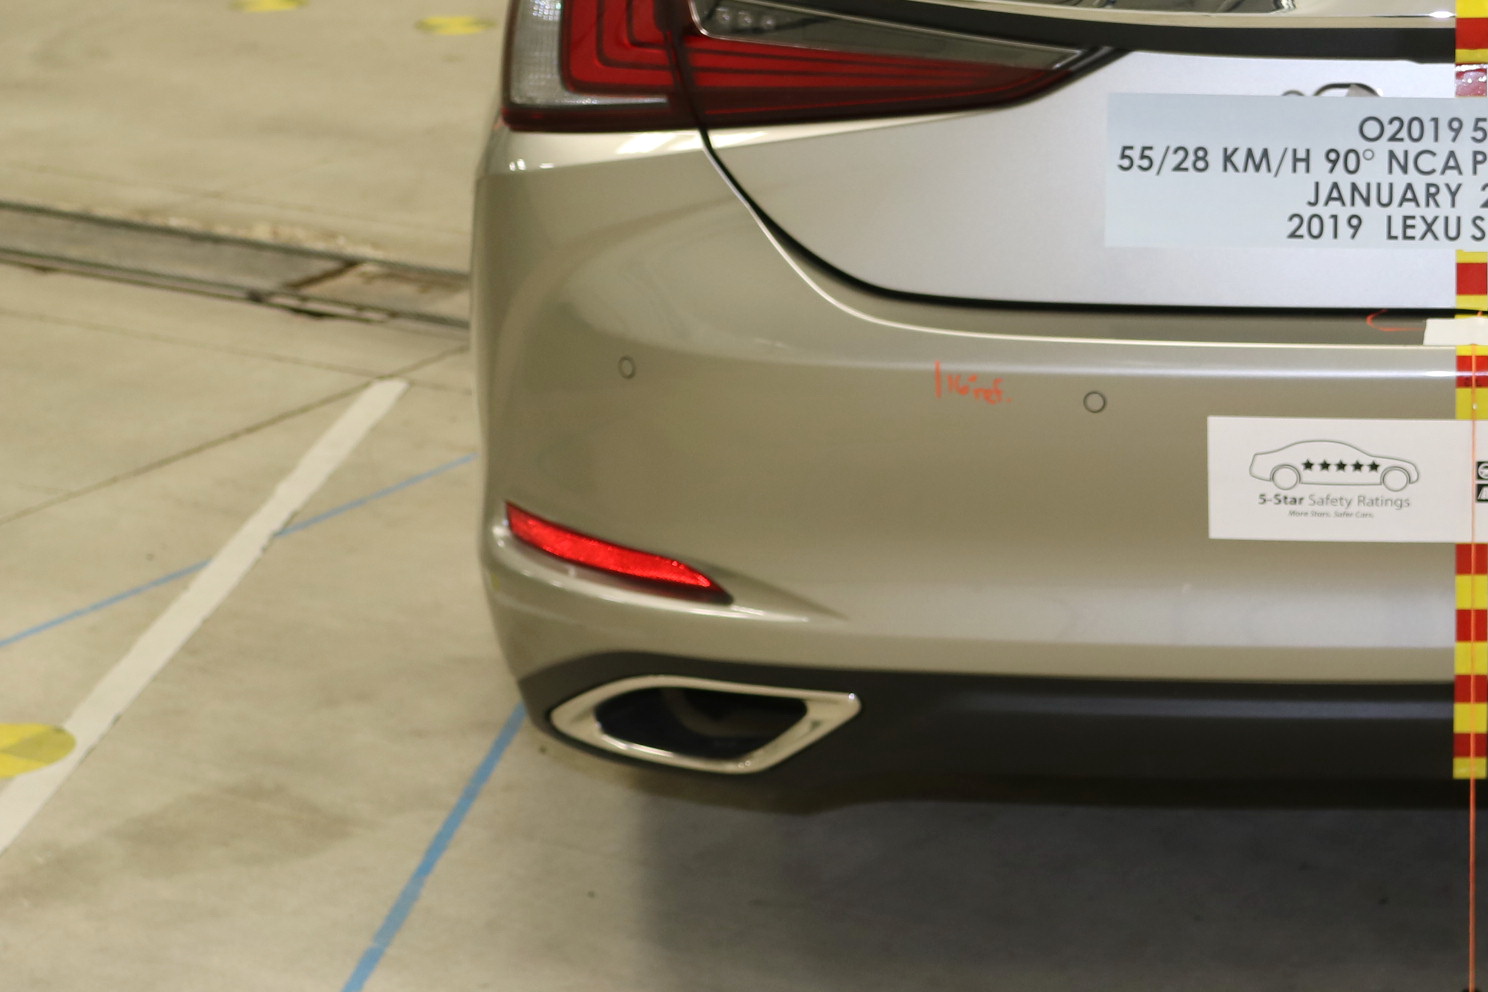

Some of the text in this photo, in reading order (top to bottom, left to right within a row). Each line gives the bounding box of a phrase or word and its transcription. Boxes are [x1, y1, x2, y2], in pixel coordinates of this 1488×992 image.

[1117, 145, 1210, 176] 55/28
[1222, 147, 1312, 178] KM/H
[1324, 148, 1376, 175] 90°
[1387, 149, 1488, 176] NCAP
[1306, 181, 1463, 208] JANUARY
[1286, 213, 1363, 240] 2019
[1386, 215, 1486, 242] LEXUS
[1258, 493, 1411, 510] 5-Star Safety Ratings
